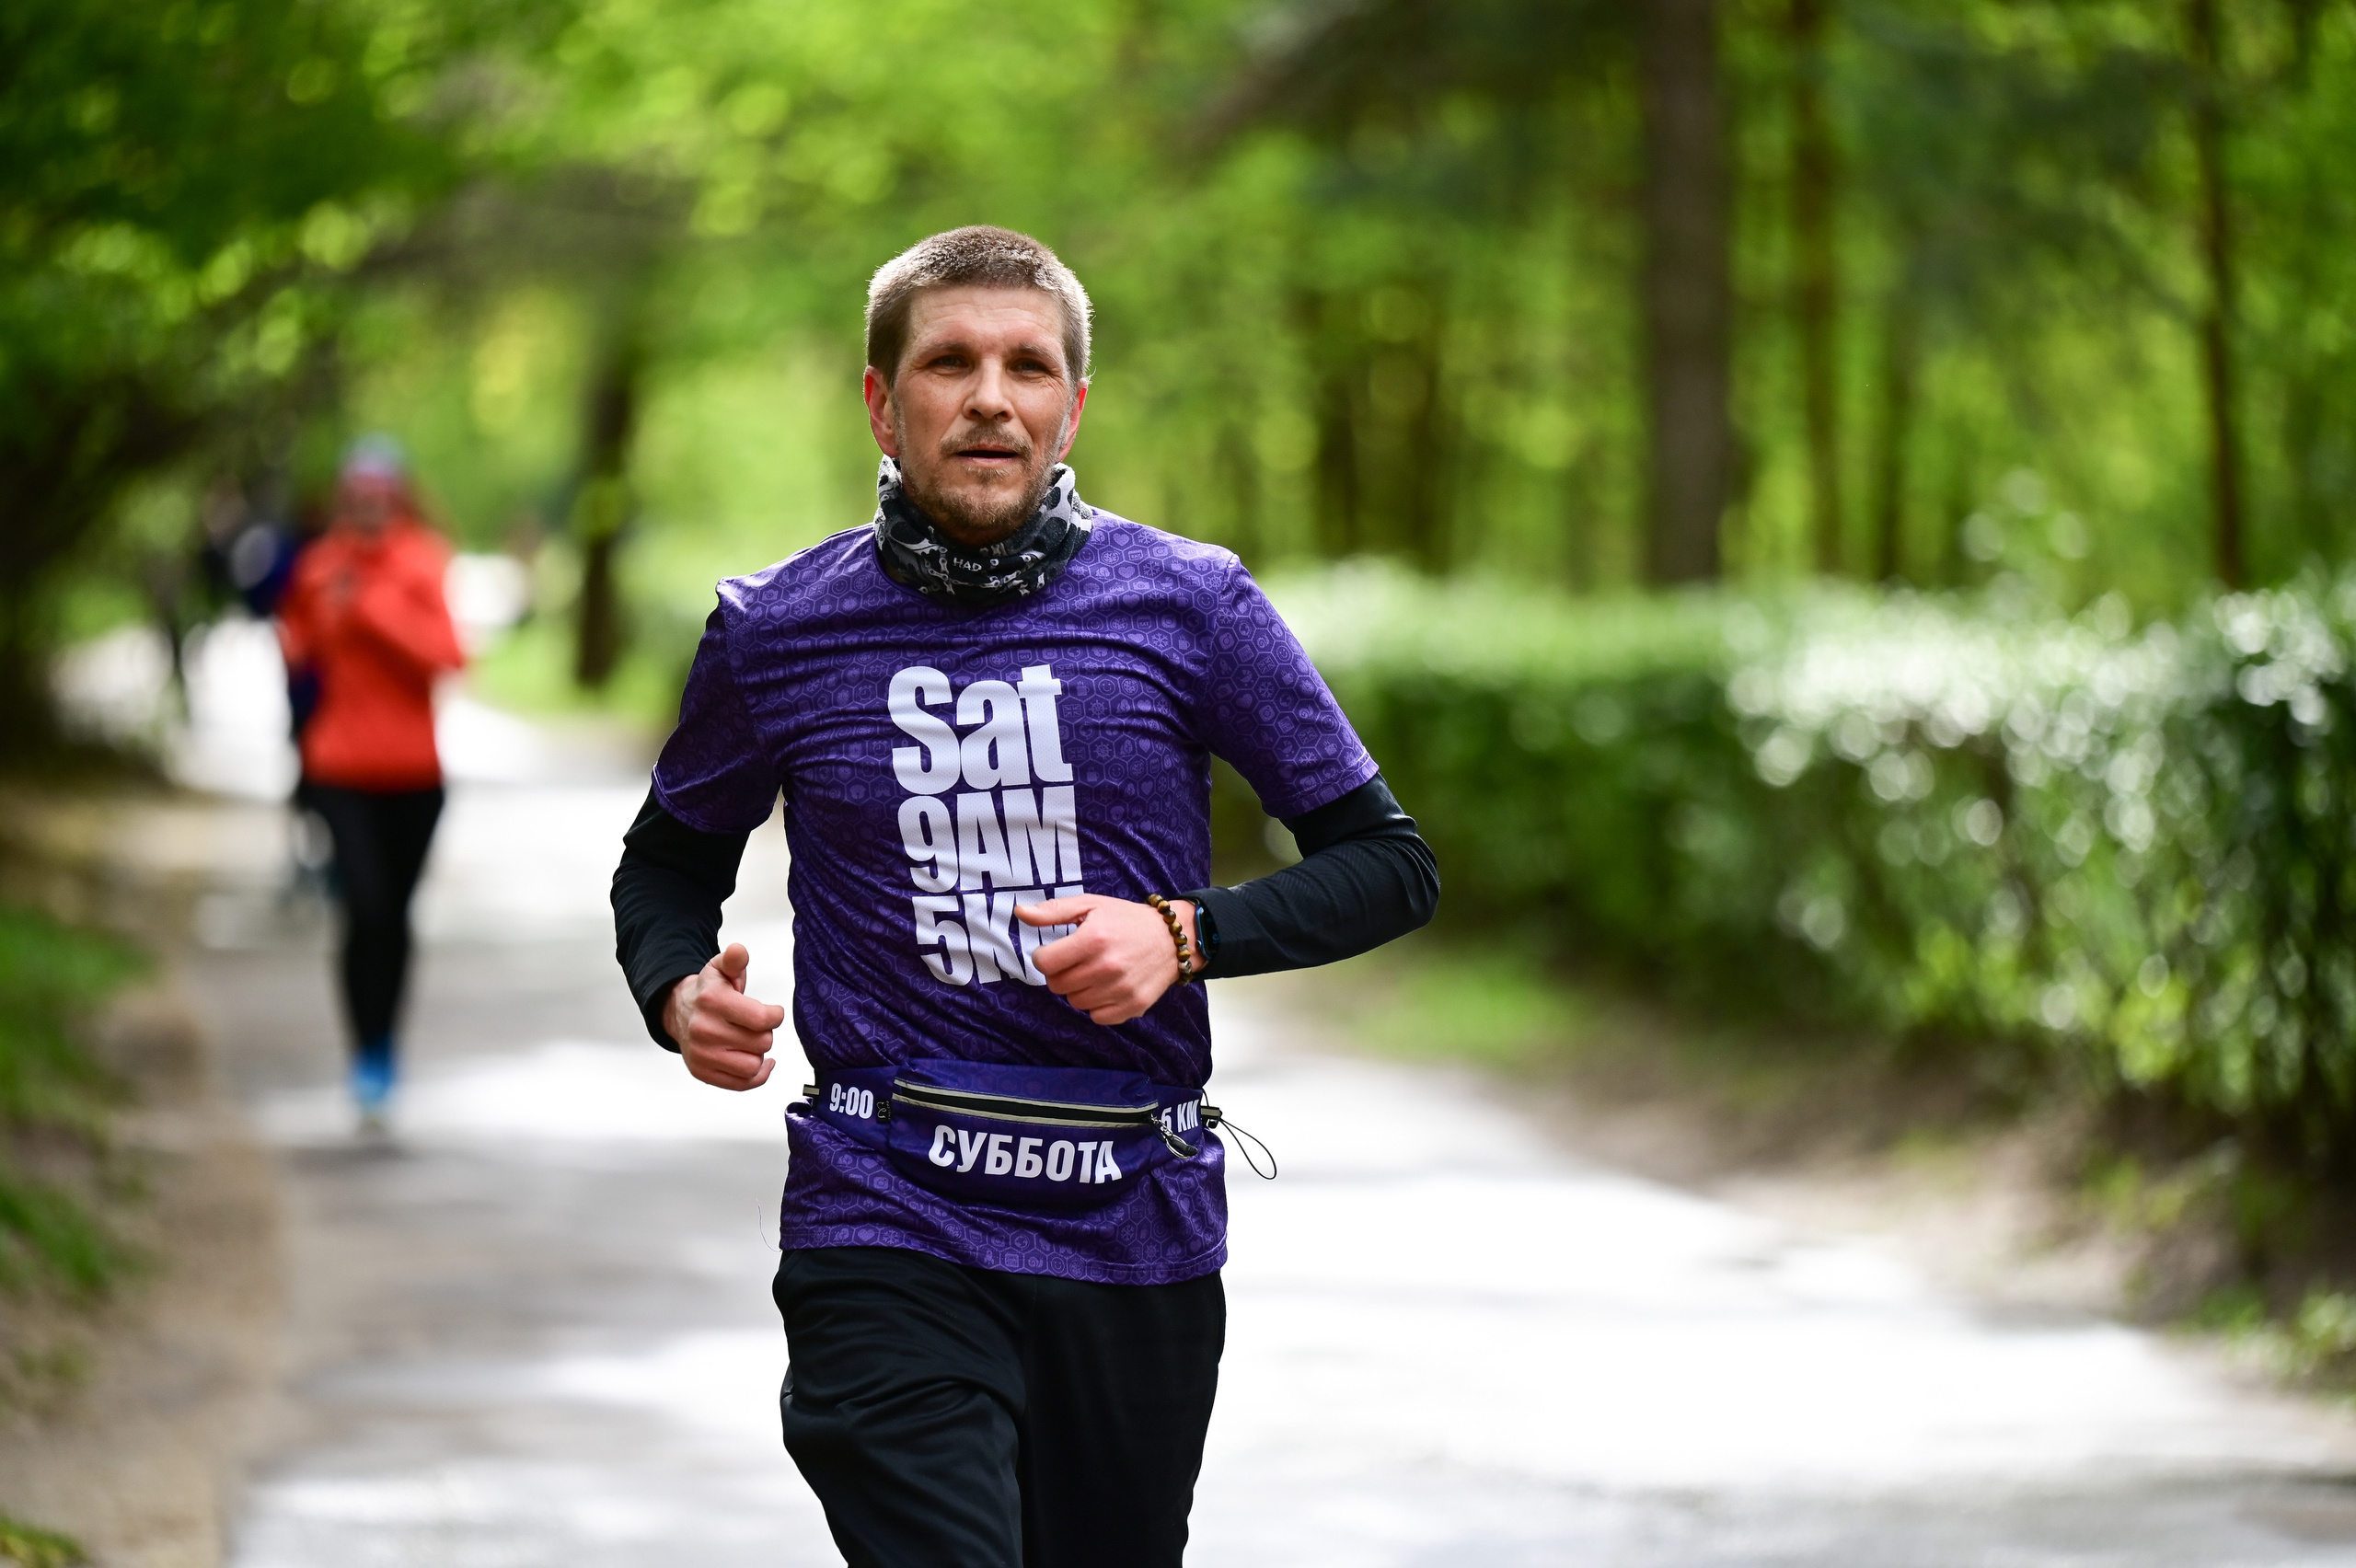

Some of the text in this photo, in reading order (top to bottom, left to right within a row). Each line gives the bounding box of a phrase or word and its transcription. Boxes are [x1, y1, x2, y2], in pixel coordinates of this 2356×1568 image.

[953, 557, 982, 571] HAD
[888, 664, 1073, 795] Sat
[897, 785, 1083, 894] 9AM
[829, 1083, 874, 1119] 9:00
[1160, 1099, 1199, 1136] 5 KM
[929, 1124, 1123, 1184] СУББОТА
